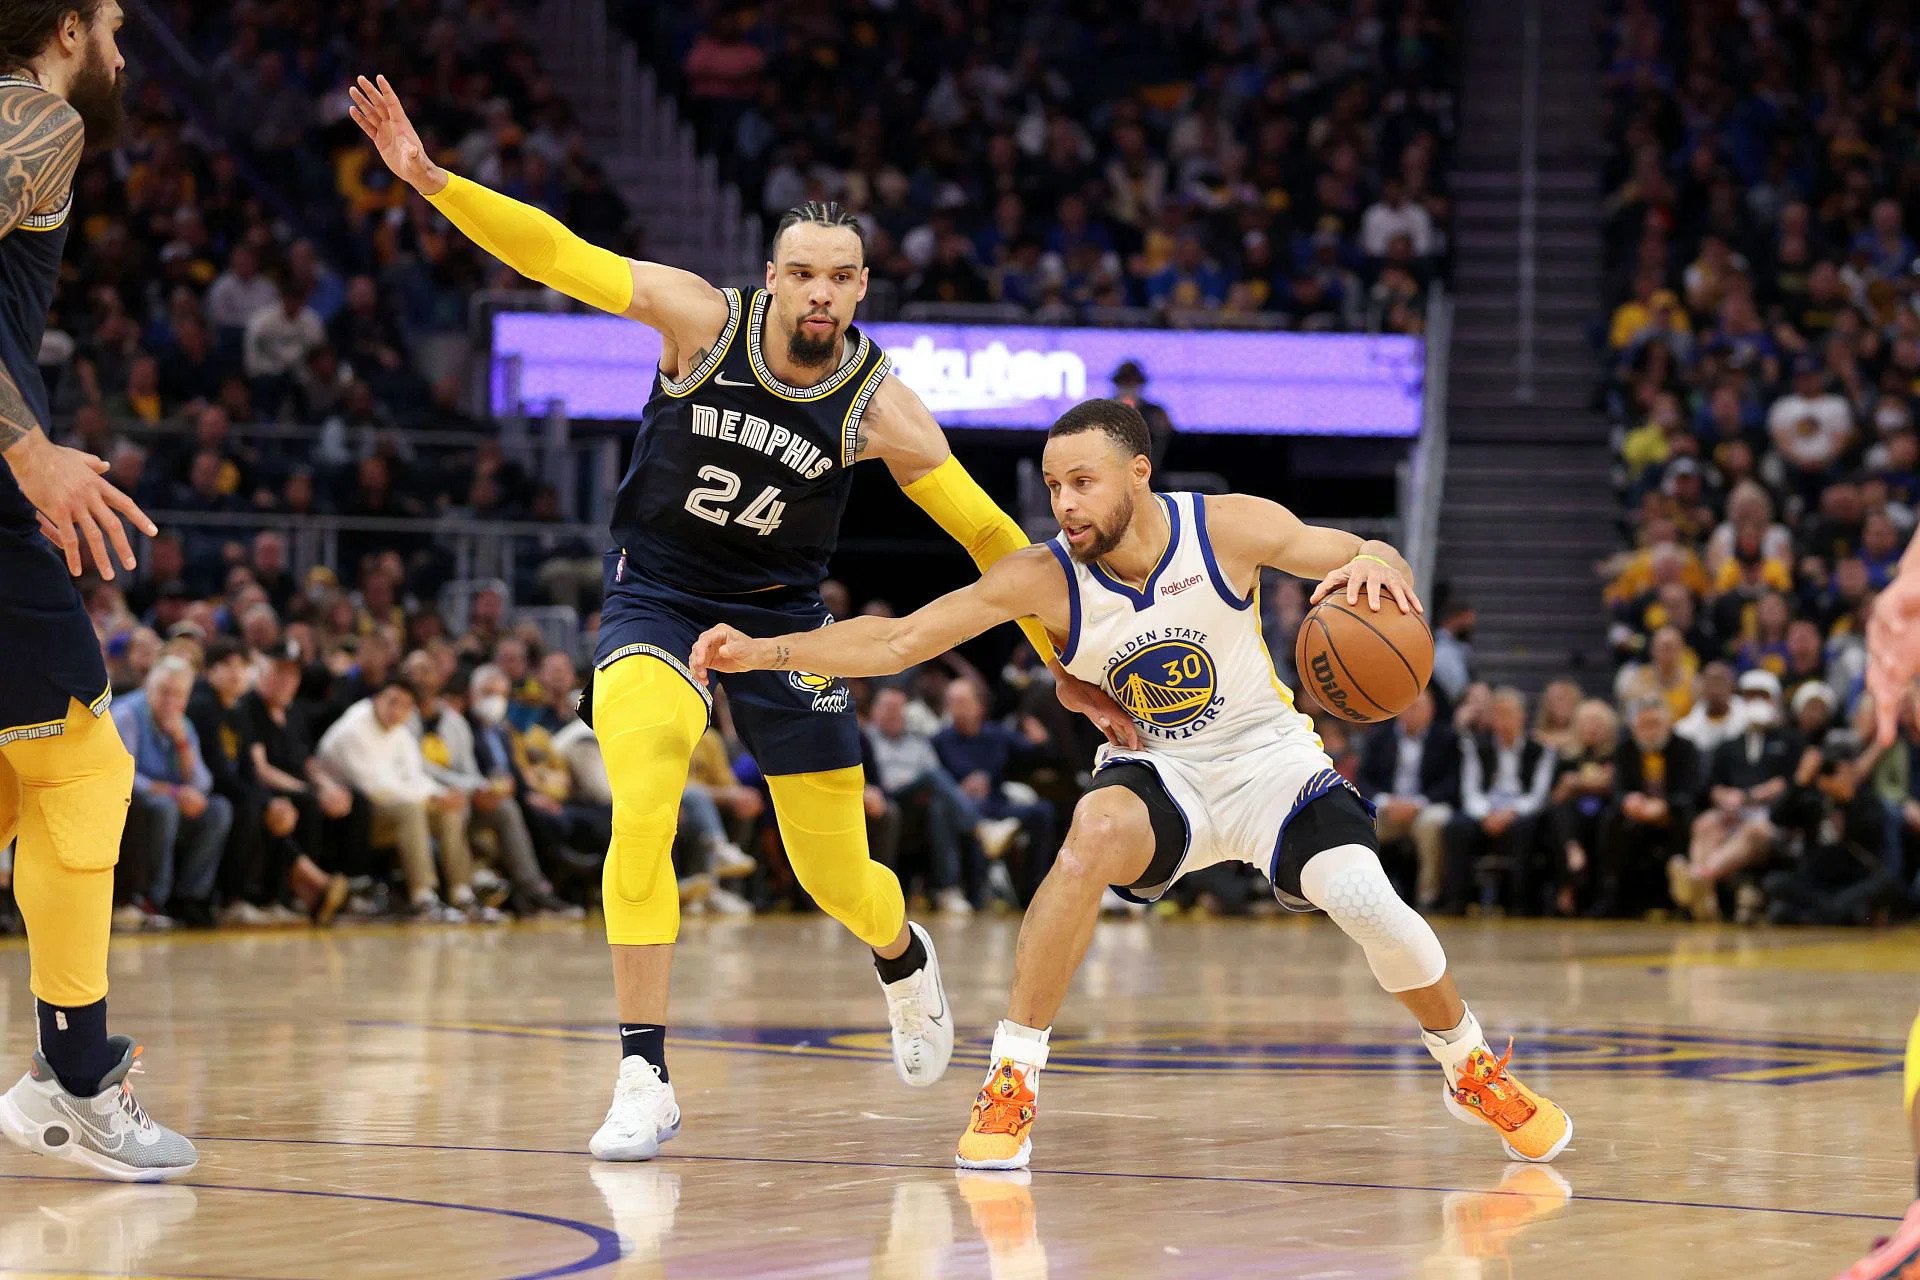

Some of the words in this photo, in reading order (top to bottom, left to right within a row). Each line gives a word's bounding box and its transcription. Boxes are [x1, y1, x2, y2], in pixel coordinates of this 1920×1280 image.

[885, 335, 1087, 403] akuten
[691, 403, 833, 480] MEMPHIS
[684, 464, 787, 536] 24
[1160, 574, 1203, 596] Rakuten
[1165, 627, 1208, 644] STATE
[1161, 653, 1202, 687] 30
[1311, 650, 1371, 720] Wilson
[1132, 695, 1225, 740] ARRIORS
